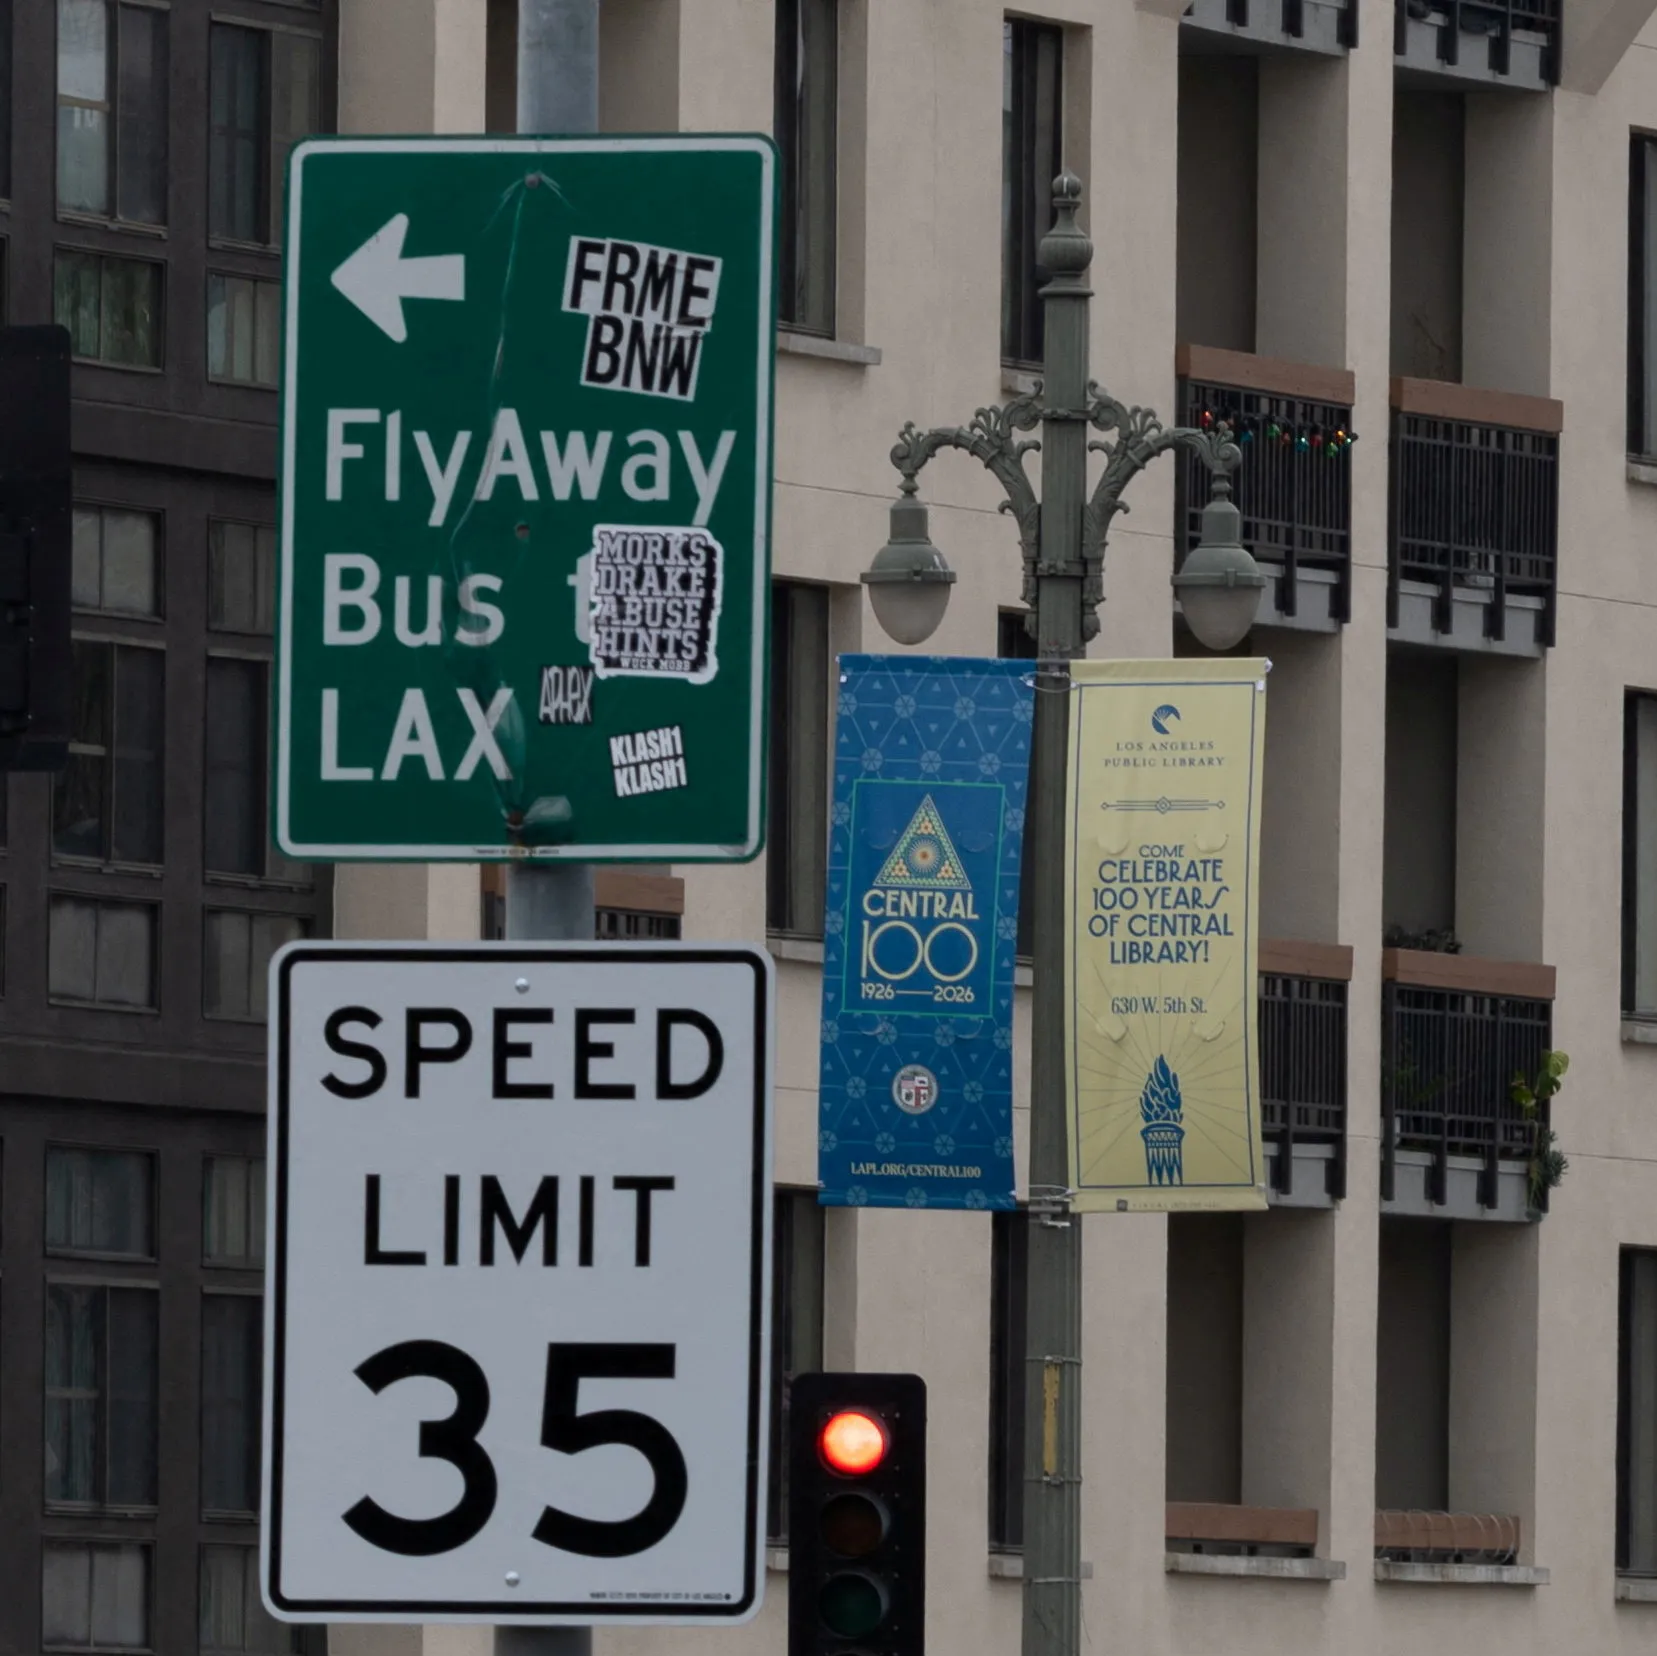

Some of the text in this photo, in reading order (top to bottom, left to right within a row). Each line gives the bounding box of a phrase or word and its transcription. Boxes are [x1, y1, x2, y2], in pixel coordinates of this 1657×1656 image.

[569, 239, 715, 328] FRME
[585, 313, 700, 397] BNW
[325, 407, 737, 527] FlyAway
[597, 531, 708, 566] MORKS
[596, 564, 706, 598] DRAKE
[322, 553, 505, 647] Bus
[596, 596, 702, 629] ABUSE
[595, 626, 698, 660] HINTS
[320, 687, 513, 782] LAX
[1116, 740, 1214, 751] LOS ANGELES
[1103, 756, 1225, 768] PUBLIC LIBRARY
[1138, 844, 1184, 859] COME
[1098, 859, 1223, 884] CELEBRATE
[862, 889, 978, 921] CENTRAL
[1093, 886, 1230, 911] 100 YEARS
[1088, 913, 1234, 938] OF CENTRAL
[861, 920, 978, 982] 100
[1110, 940, 1209, 965] LIBRARY!
[1111, 996, 1208, 1015] 630 W. 5th St.
[320, 1005, 724, 1101] SPEED
[363, 1174, 676, 1268] LIMIT
[342, 1338, 688, 1558] 35
